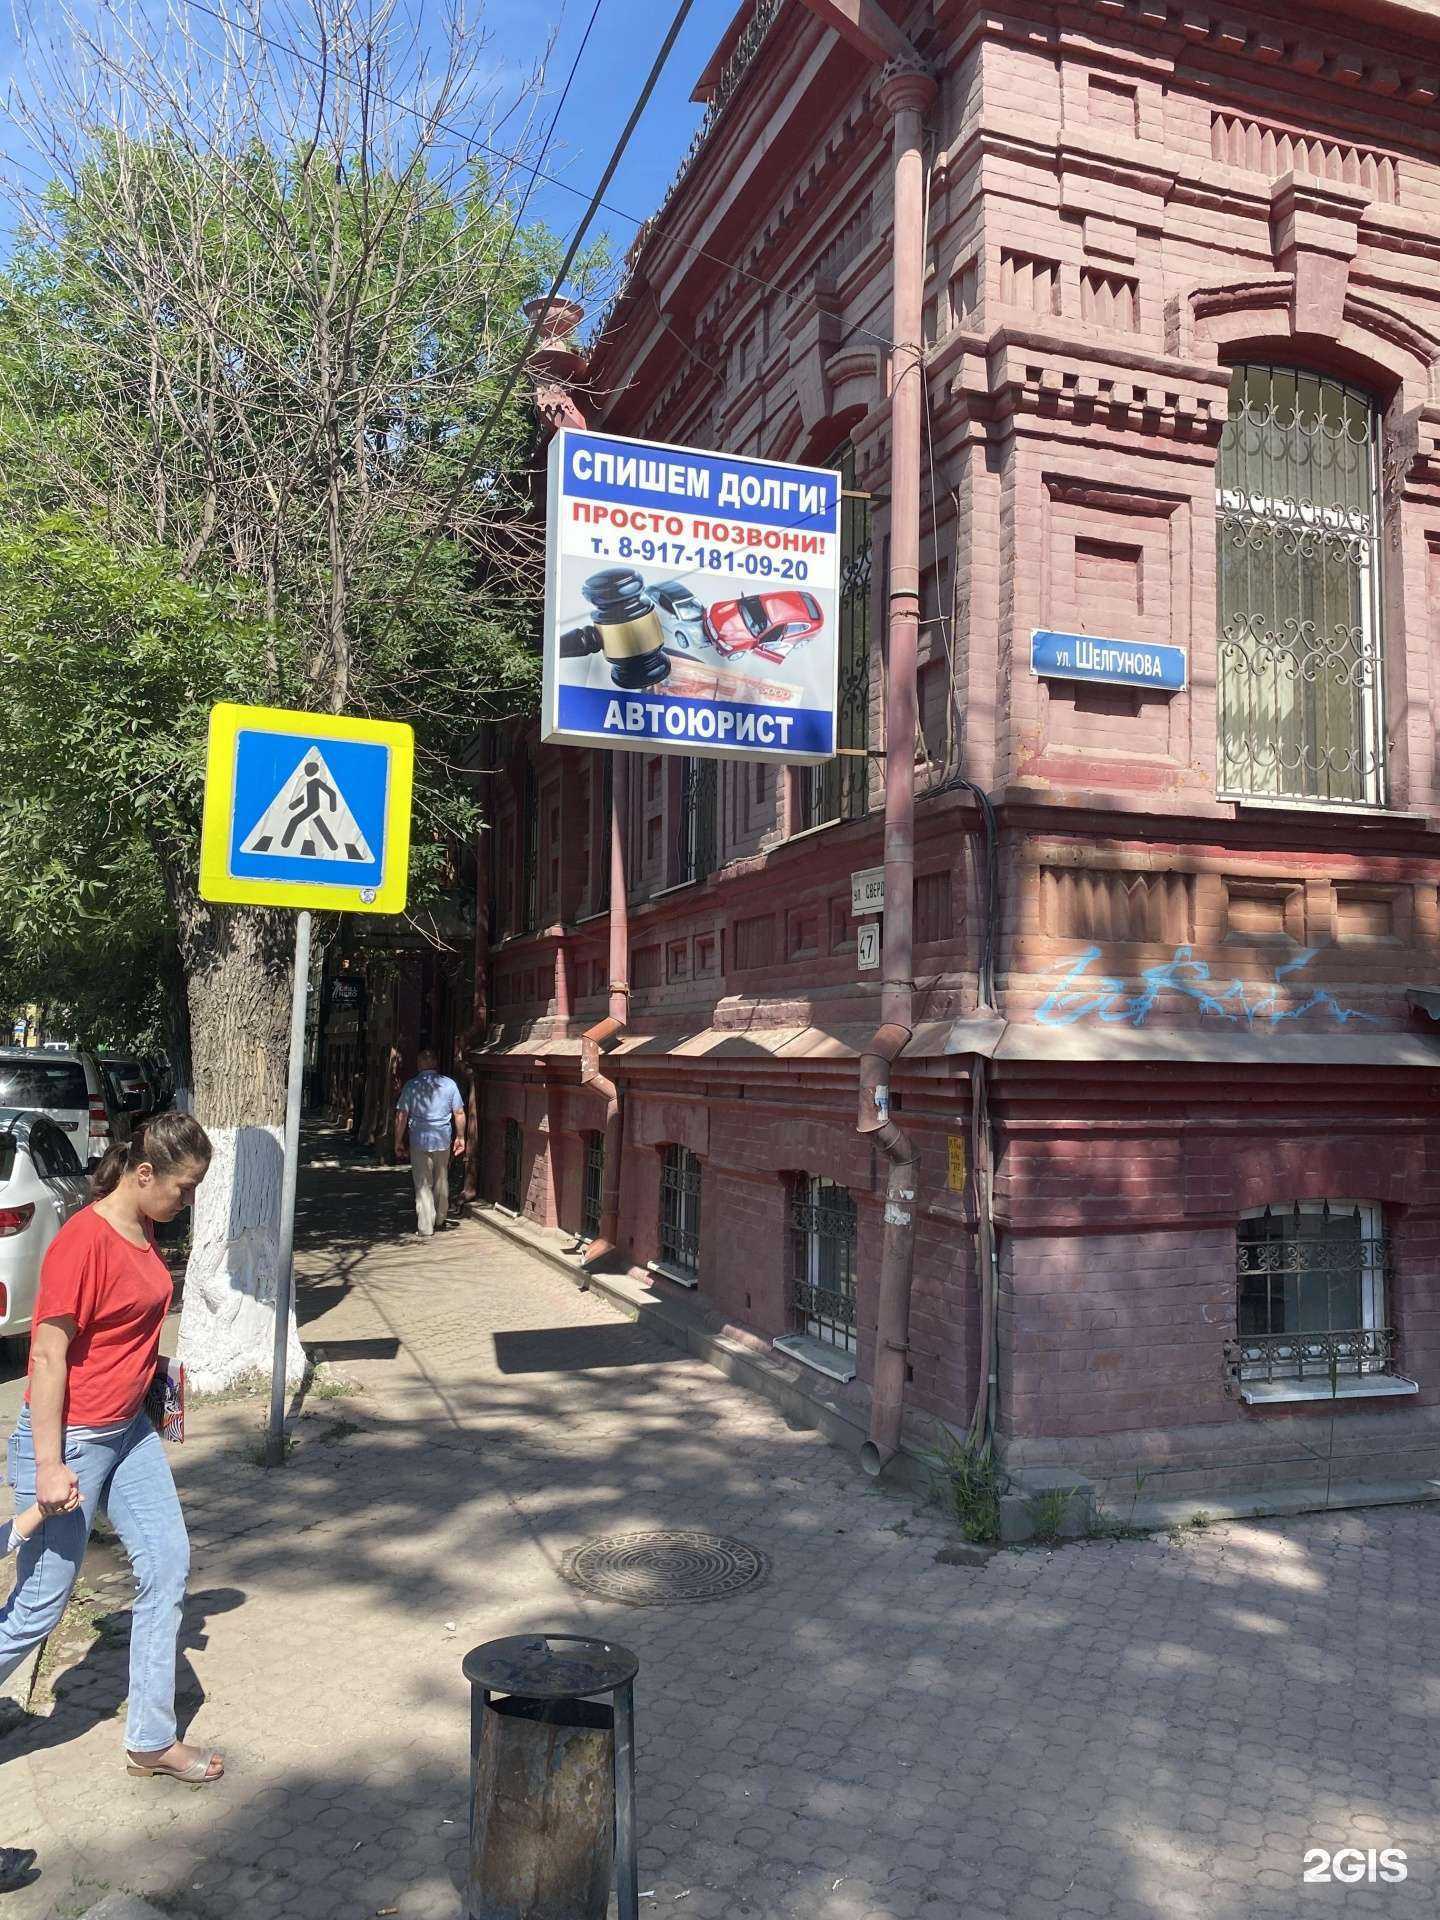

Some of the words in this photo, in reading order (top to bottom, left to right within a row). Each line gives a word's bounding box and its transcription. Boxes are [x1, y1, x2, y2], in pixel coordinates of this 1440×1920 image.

[572, 449, 710, 499] СПИШЕМ
[718, 472, 827, 516] ДОЛГИ!
[572, 502, 683, 536] ПРОСТО
[693, 520, 826, 555] ПОЗВОНИ!
[618, 536, 809, 581] 8-917-181-09-20
[1076, 640, 1162, 677] ШЕЛГУНОВА
[603, 700, 794, 745] АВТОЮРИСТ
[859, 934, 873, 960] 47
